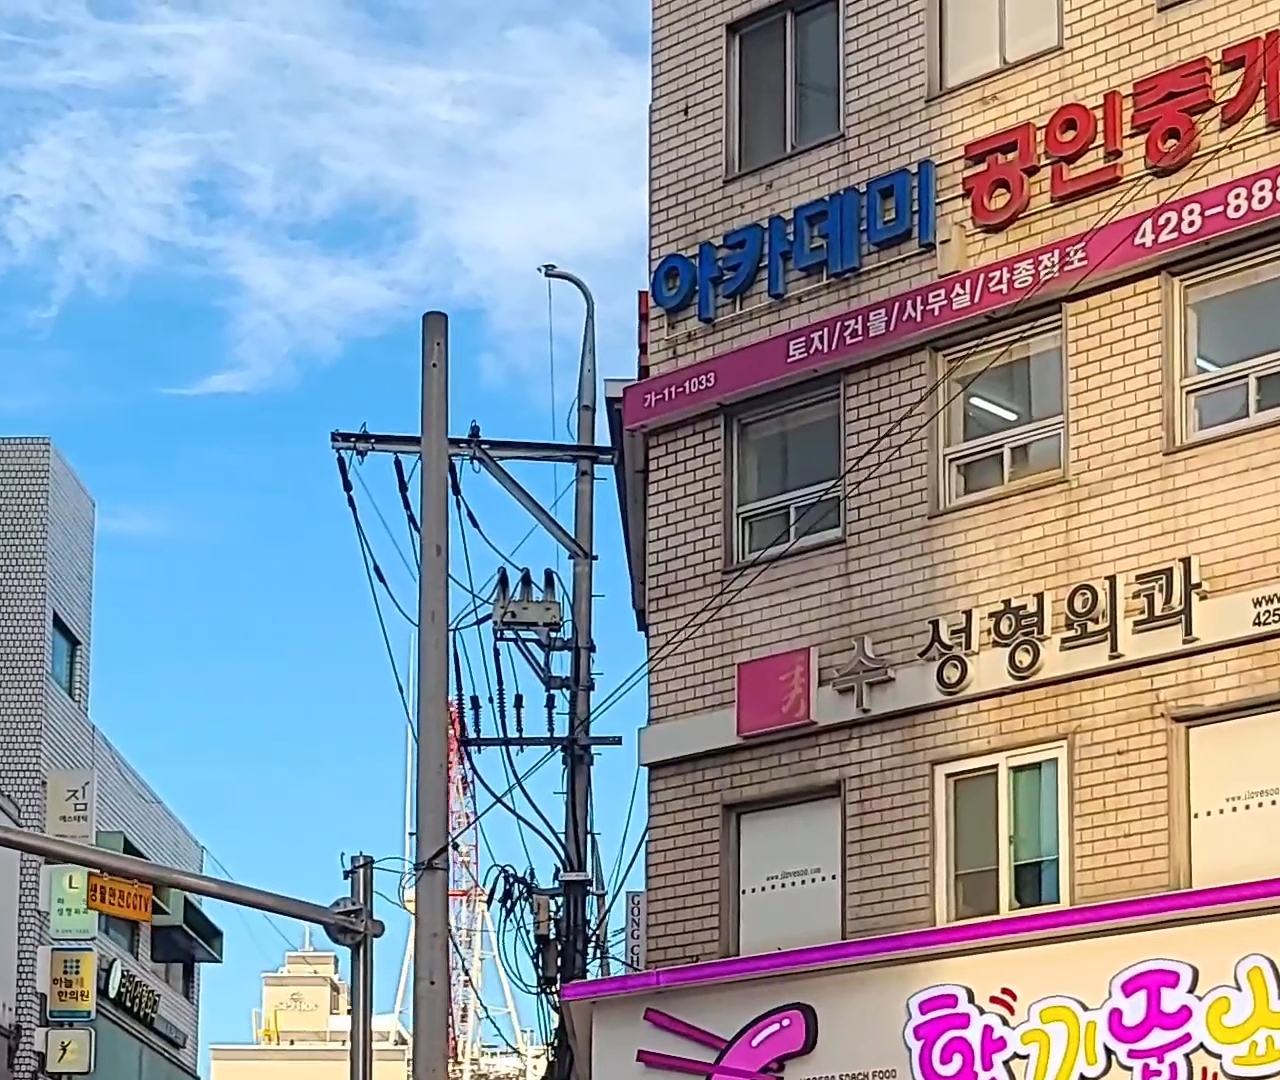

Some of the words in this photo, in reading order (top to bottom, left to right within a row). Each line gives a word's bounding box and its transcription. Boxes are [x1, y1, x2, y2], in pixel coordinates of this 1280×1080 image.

[651, 159, 936, 323] 아카데미
[786, 240, 1088, 364] 토지/건물/사무실/각종점포
[643, 372, 716, 409] 가-11-1033
[831, 636, 895, 713] 수
[917, 556, 1209, 696] 성형외과
[631, 894, 640, 940] GONG
[872, 1068, 897, 1080] FOOD
